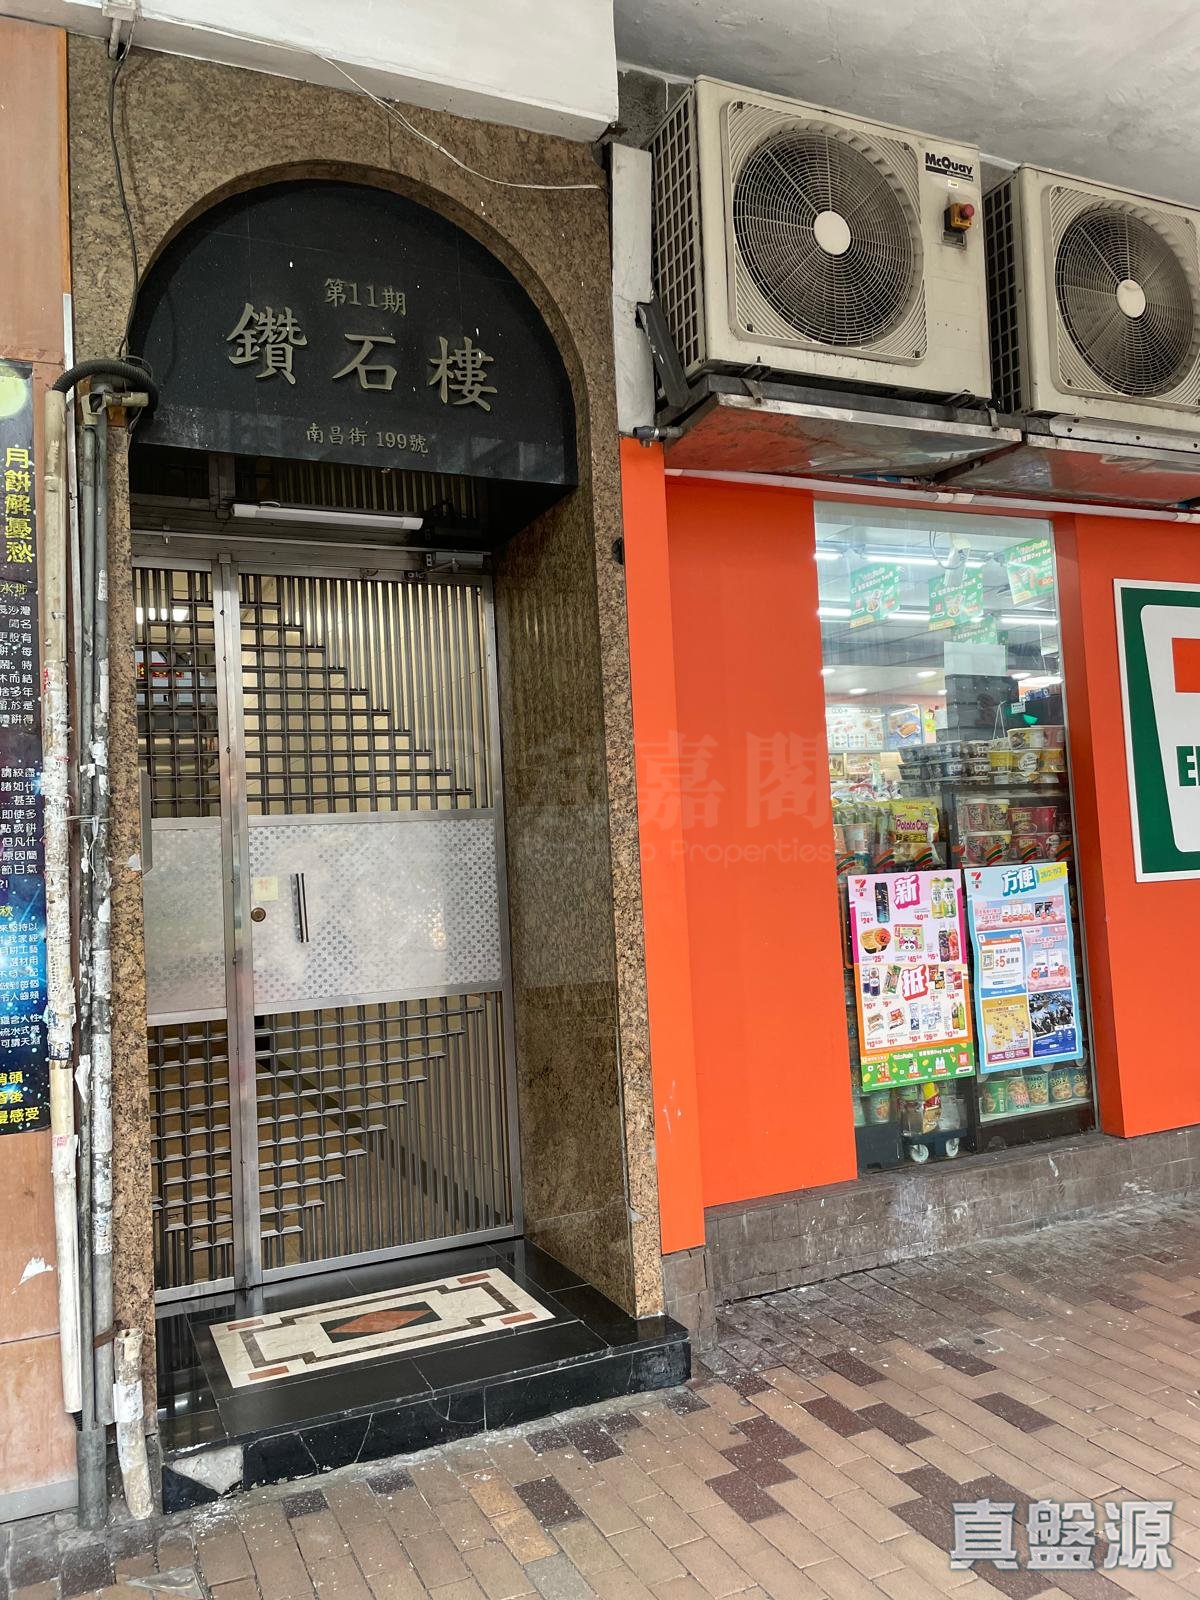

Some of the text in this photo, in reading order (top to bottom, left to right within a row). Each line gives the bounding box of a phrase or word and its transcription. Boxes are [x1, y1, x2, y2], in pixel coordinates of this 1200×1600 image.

[925, 152, 973, 175] McQuay
[324, 277, 408, 316] 第11期
[226, 302, 498, 413] 鑽石樓
[306, 422, 429, 454] 南昌街 199號
[4, 447, 33, 564] 月餅解憂愁
[894, 874, 921, 909] 新
[1002, 866, 1037, 896] 方便
